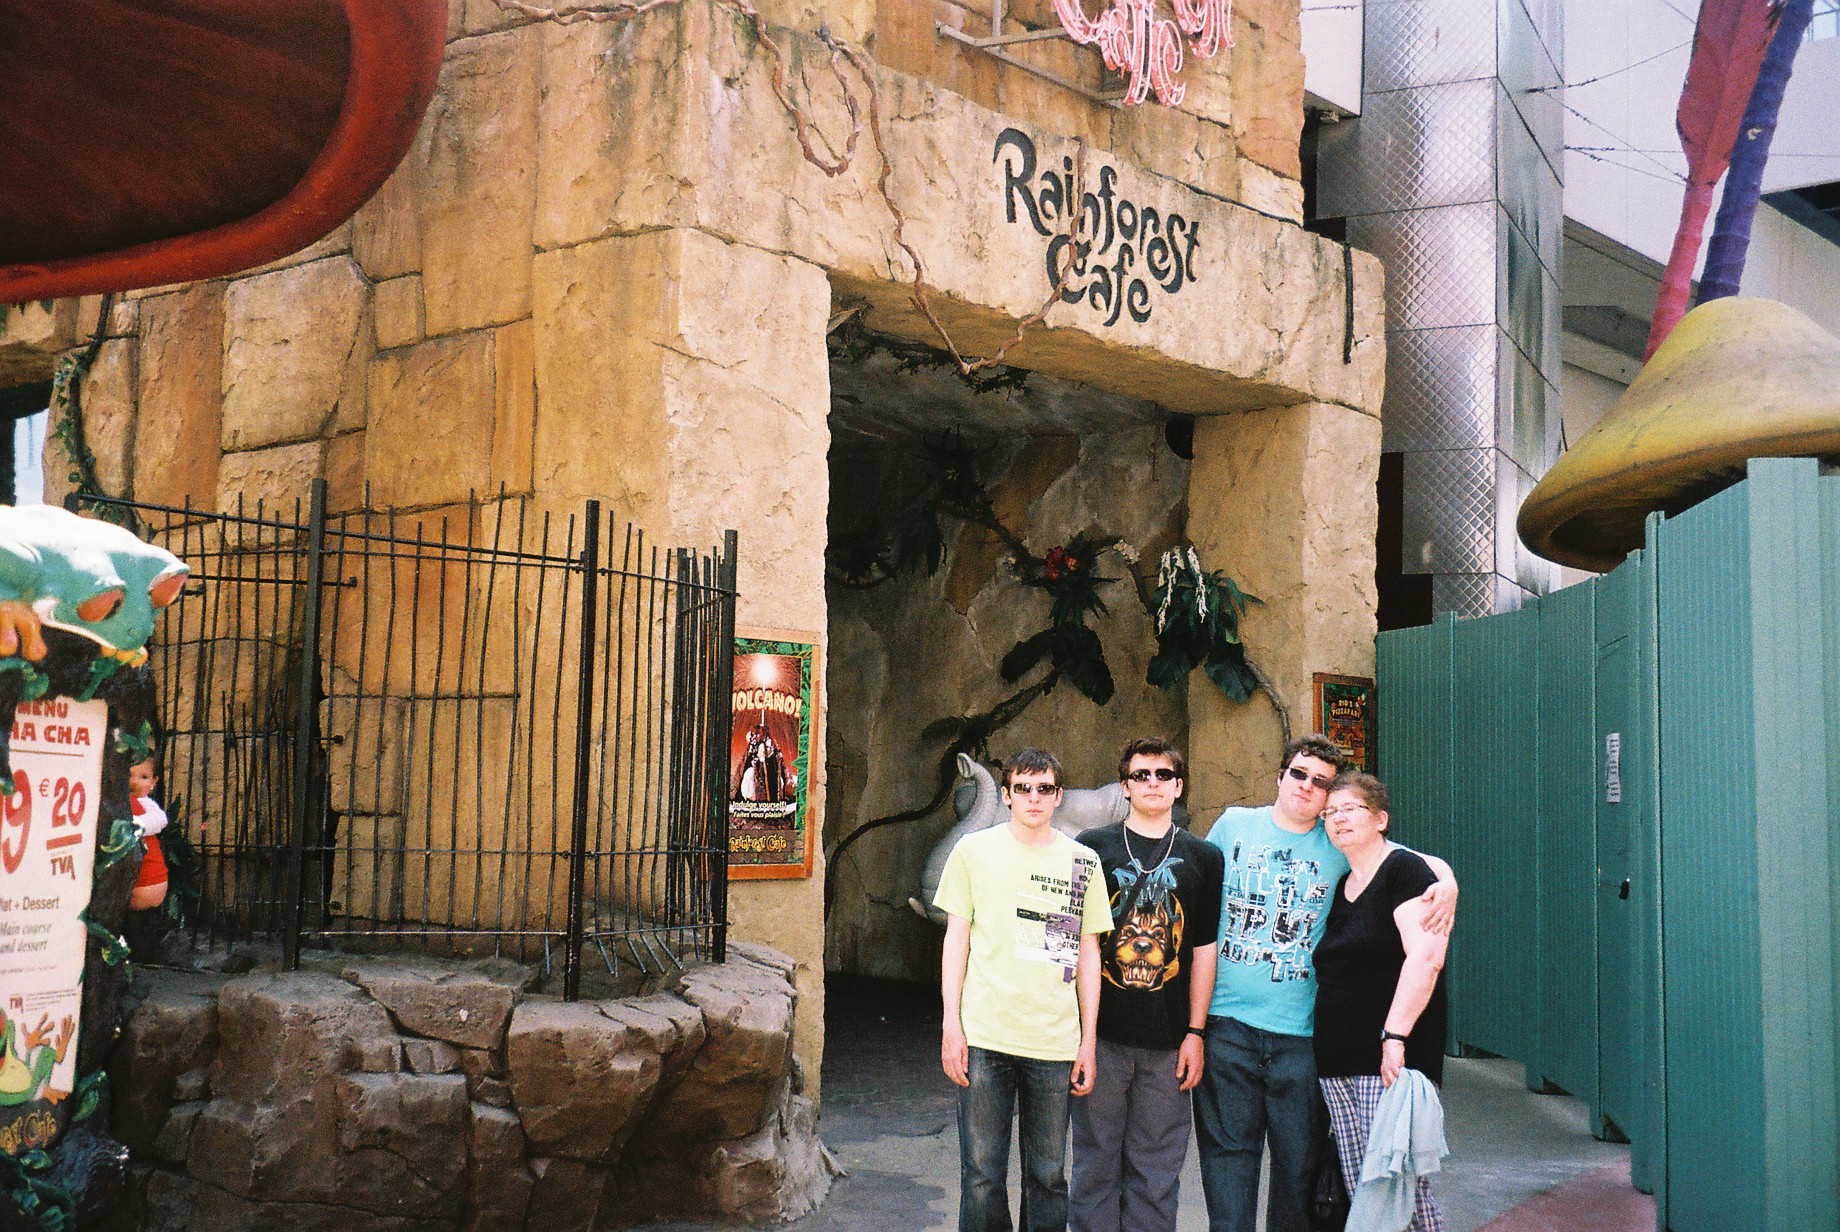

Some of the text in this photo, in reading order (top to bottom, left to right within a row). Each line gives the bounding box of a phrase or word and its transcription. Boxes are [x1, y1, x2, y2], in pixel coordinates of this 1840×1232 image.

[993, 127, 1200, 294] Rainforest
[1046, 233, 1153, 327] Cafe
[17, 698, 69, 719] MENU
[44, 725, 91, 746] CHA
[732, 800, 757, 809] Indulge
[50, 854, 76, 881] TVA
[23, 896, 60, 911] Dessert
